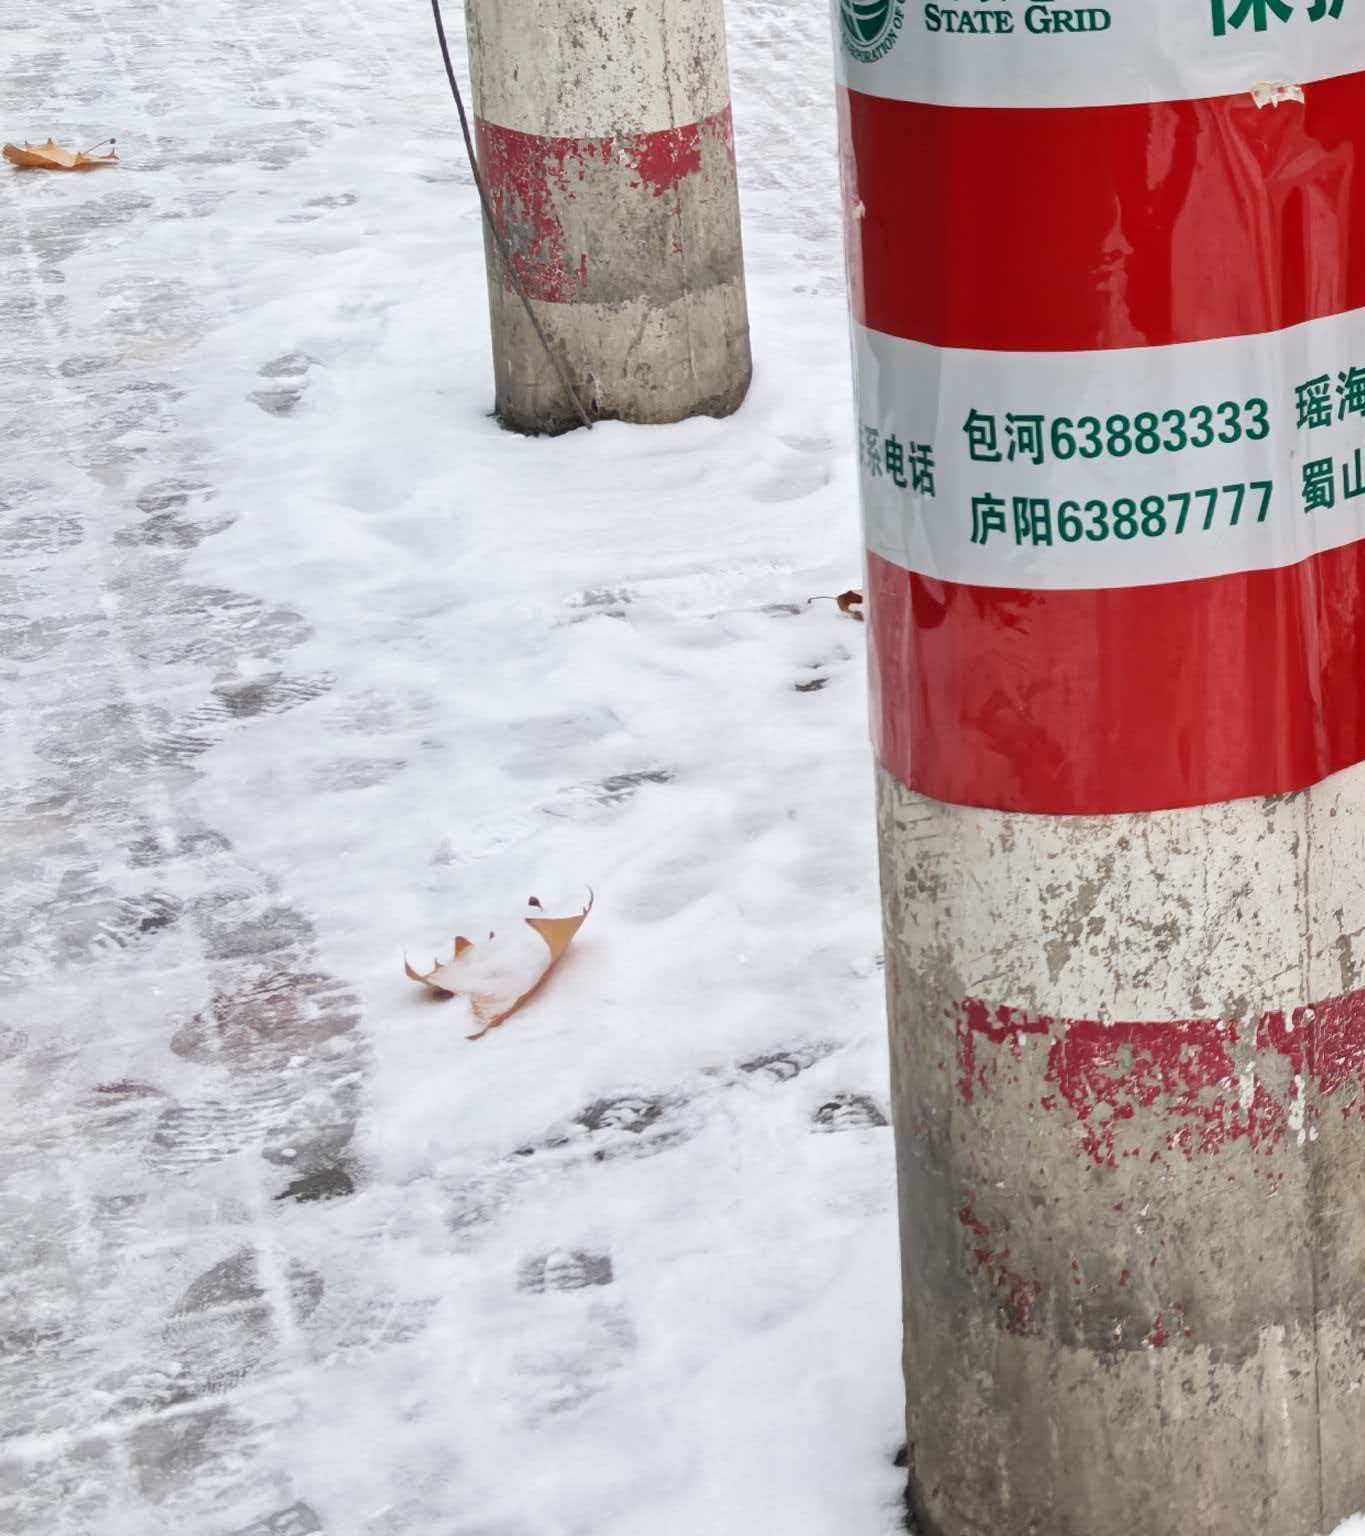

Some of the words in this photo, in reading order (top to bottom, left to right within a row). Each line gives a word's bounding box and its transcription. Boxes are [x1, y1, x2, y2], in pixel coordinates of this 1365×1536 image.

[925, 3, 1015, 34] STATE
[1024, 5, 1112, 34] GRID
[860, 425, 936, 498] 系电话
[962, 398, 1271, 465] 包河63883333
[970, 480, 1275, 547] 庐阳63887777
